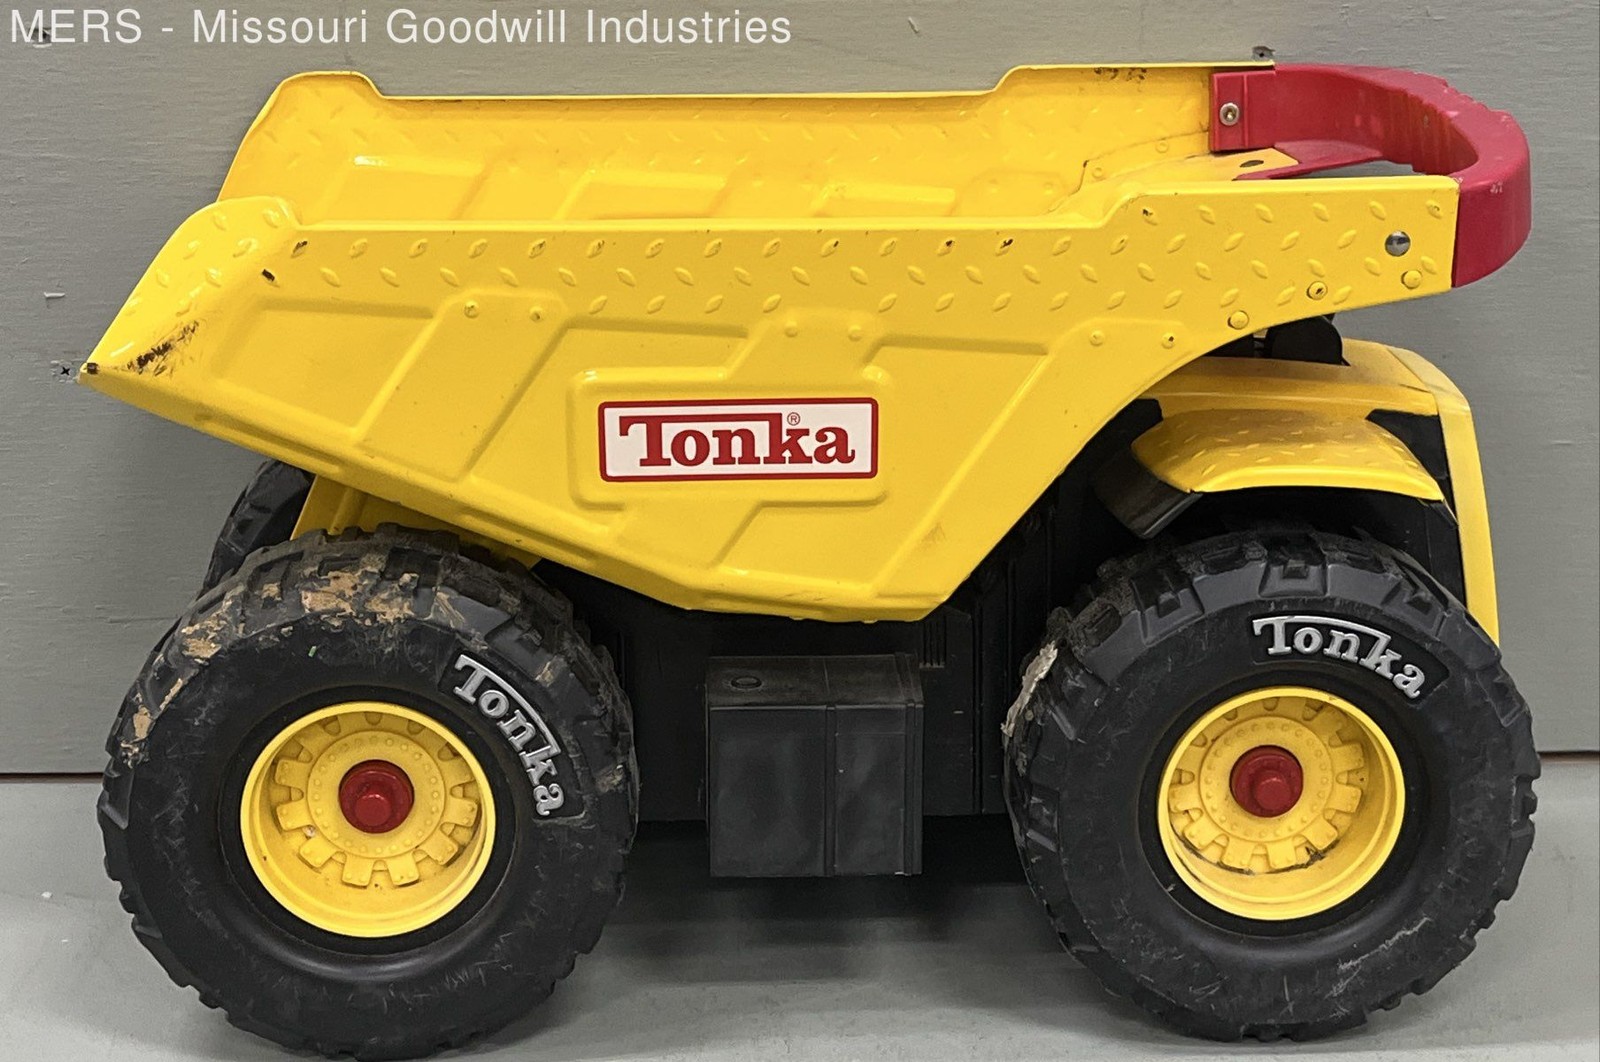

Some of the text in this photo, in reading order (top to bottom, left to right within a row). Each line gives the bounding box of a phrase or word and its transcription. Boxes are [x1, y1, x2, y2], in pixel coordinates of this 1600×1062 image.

[619, 412, 856, 467] Tonka
[1252, 615, 1426, 699] Tonka
[453, 654, 565, 816] Tonka
